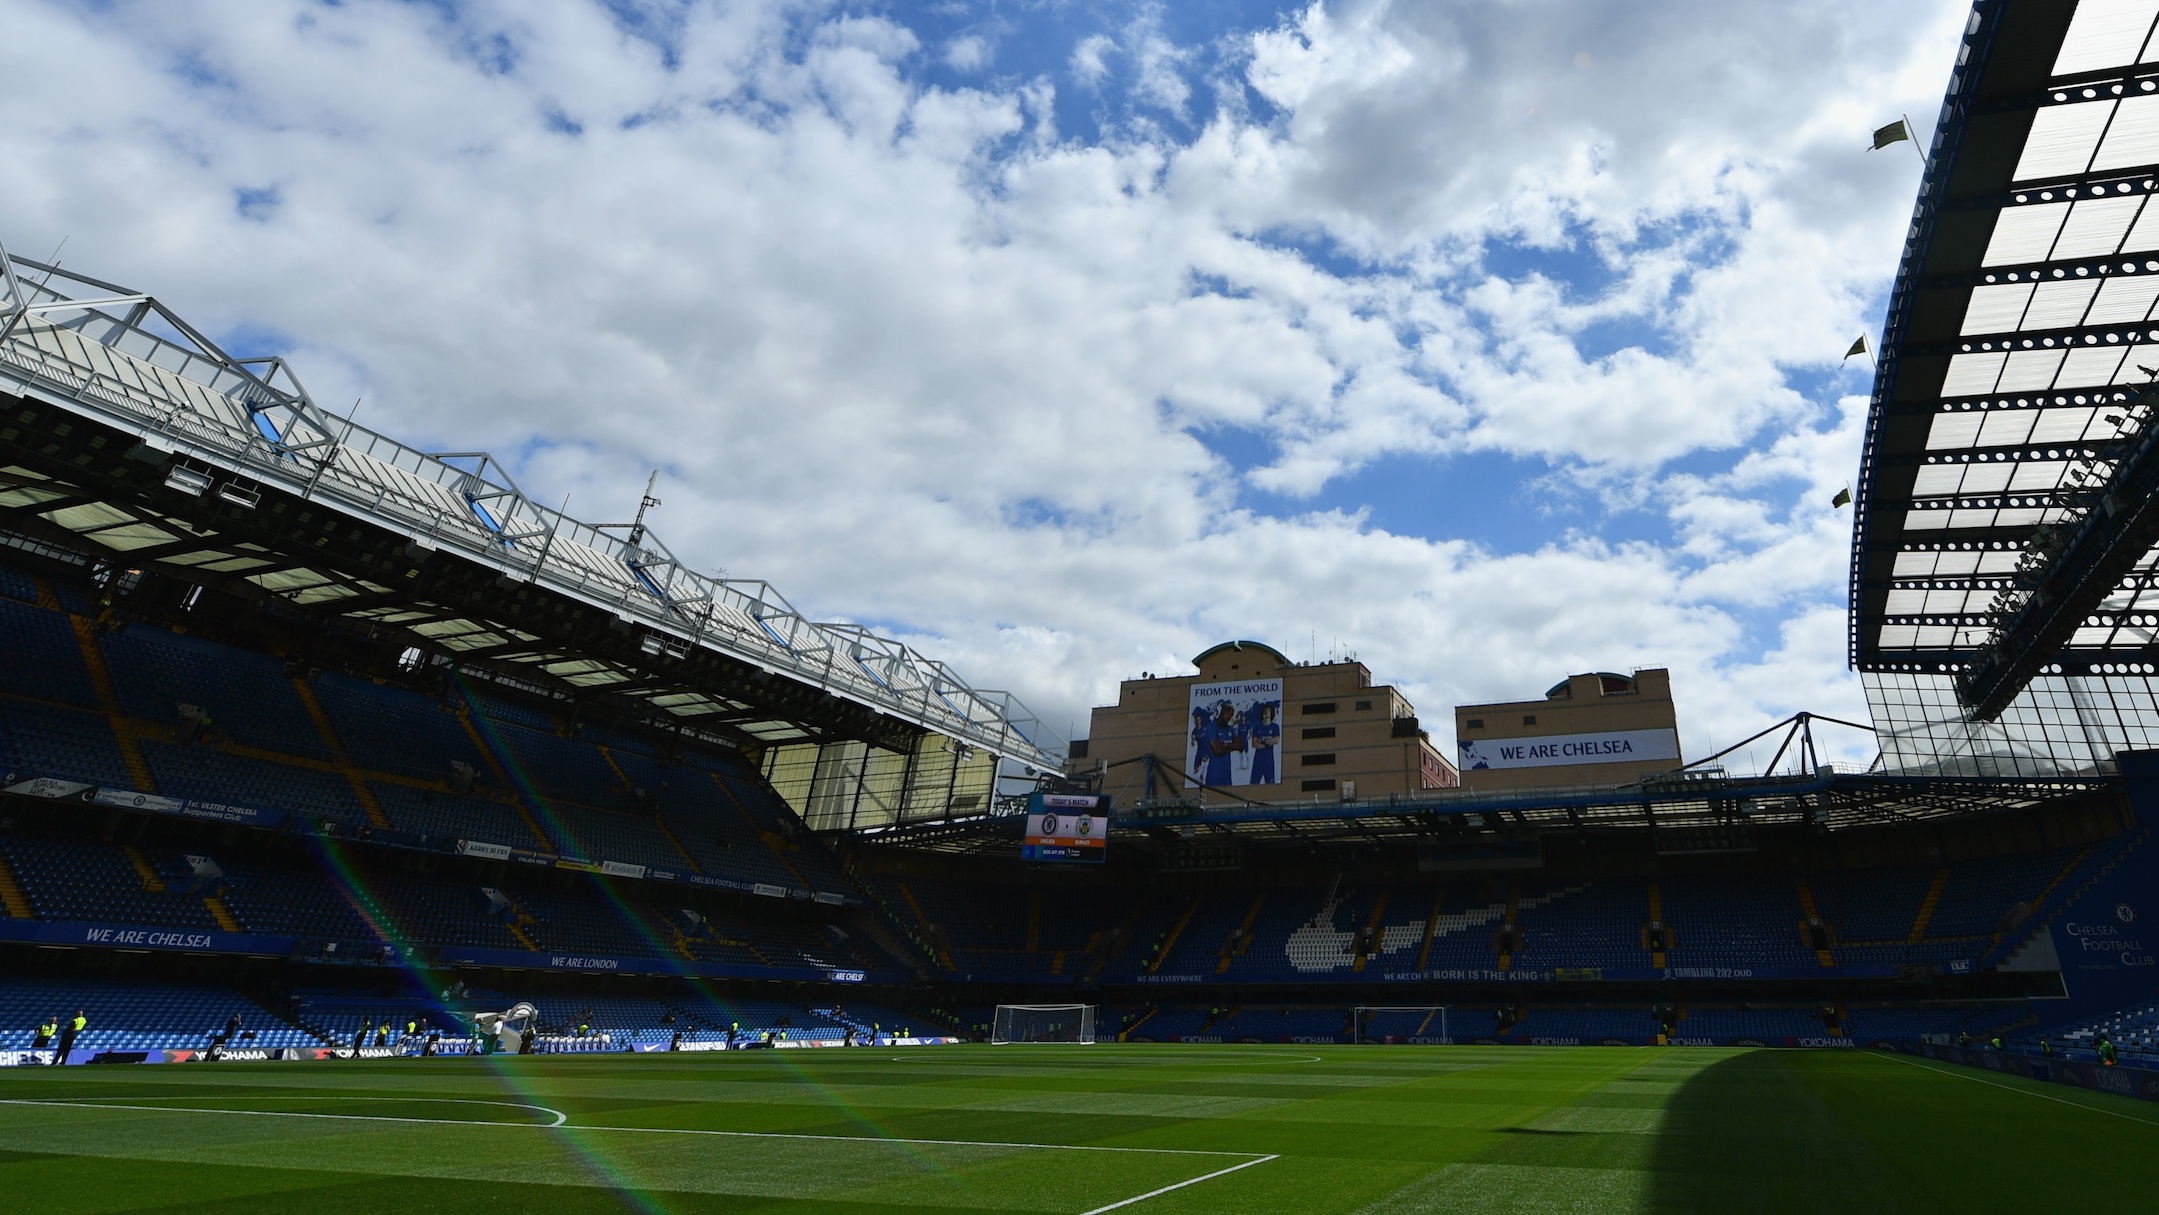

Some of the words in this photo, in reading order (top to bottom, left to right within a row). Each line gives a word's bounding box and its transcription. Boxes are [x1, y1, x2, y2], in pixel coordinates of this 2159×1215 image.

[1195, 687, 1221, 697] FROM
[1222, 685, 1241, 696] THE
[1244, 683, 1278, 694] WORLD
[1500, 746, 1525, 760] WE
[1529, 744, 1559, 758] ARE
[1563, 740, 1633, 756] CHELSEA
[183, 807, 223, 819] Supporters
[224, 812, 242, 822] Club
[201, 802, 226, 812] ULSTER
[227, 805, 257, 816] CHELSEA
[690, 874, 715, 885] CHELSEA
[715, 877, 741, 889] FOOTBALL
[2066, 922, 2119, 936] CHELSEA
[86, 928, 114, 942] WE
[113, 930, 147, 944] ARE
[147, 932, 212, 948] CHELSEA
[2081, 937, 2144, 951] FOOTBALL
[551, 956, 566, 967] WE
[565, 958, 584, 968] ARE
[583, 959, 618, 969] LONDON
[2121, 952, 2155, 966] CLUB
[835, 972, 845, 980] ARE
[1384, 973, 1395, 981] WE
[1396, 973, 1410, 981] ARE
[1433, 970, 1465, 980] BORN
[1468, 970, 1479, 980] IS
[1482, 970, 1506, 981] THE
[1509, 971, 1538, 981] KING
[1674, 967, 1715, 978] TAMBLING
[1733, 968, 1753, 977] OUD
[1148, 975, 1160, 983] ARE
[1160, 975, 1203, 983] EVERYWHERE
[1530, 1037, 1579, 1045] YOKOHAMA
[1665, 1038, 1714, 1046] OKOHAMA
[1798, 1038, 1855, 1048] YOKOHAMA
[0, 1051, 62, 1065] CHELSE
[195, 1051, 268, 1061] YOHAMA
[332, 1048, 393, 1058] YOKHAMA
